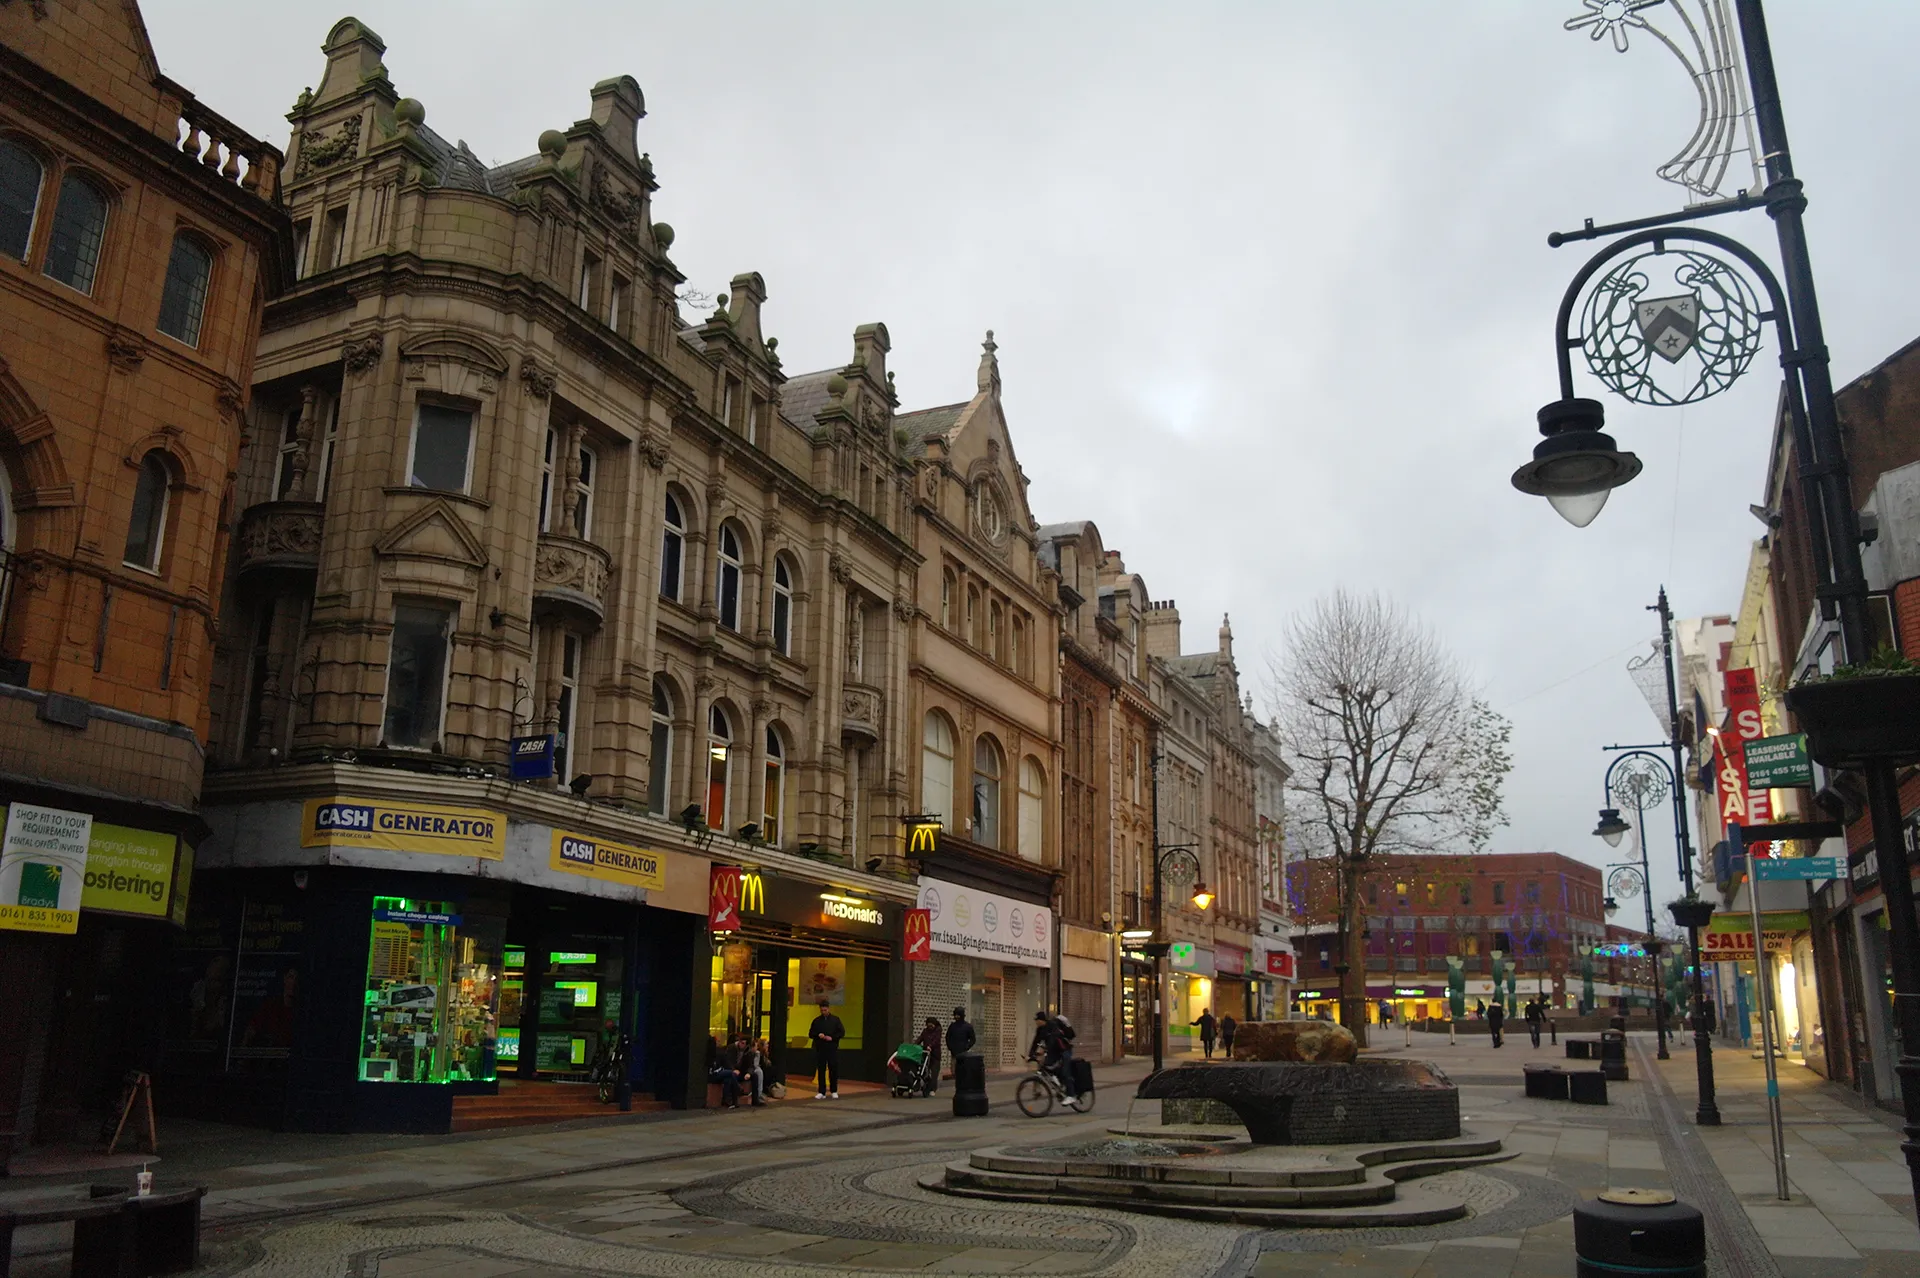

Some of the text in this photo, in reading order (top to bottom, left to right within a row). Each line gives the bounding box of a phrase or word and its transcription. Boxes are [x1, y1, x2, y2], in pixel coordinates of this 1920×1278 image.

[518, 740, 547, 752] CASH
[1746, 742, 1797, 756] LEASEHOLD
[1748, 751, 1796, 764] AVAILABLE
[16, 809, 86, 829] SHOP FIT TO YOUR
[318, 807, 494, 839] CASH GENERATOR
[22, 822, 80, 839] REQUIREMENTS
[9, 836, 84, 854] RENTAL OFFERS INVITED
[128, 843, 148, 855] lives
[150, 847, 159, 857] in
[562, 840, 657, 874] CASH GENERATOR
[131, 858, 168, 874] through
[83, 870, 165, 901] ostering
[21, 895, 55, 909] Bradys
[0, 908, 73, 923] 0161 835 1903
[407, 912, 427, 920] cheque
[428, 914, 450, 922] cashing
[823, 901, 884, 926] McDonald's
[1706, 933, 1754, 949] SALE
[1762, 932, 1787, 940] NOW
[1767, 941, 1783, 949] ON
